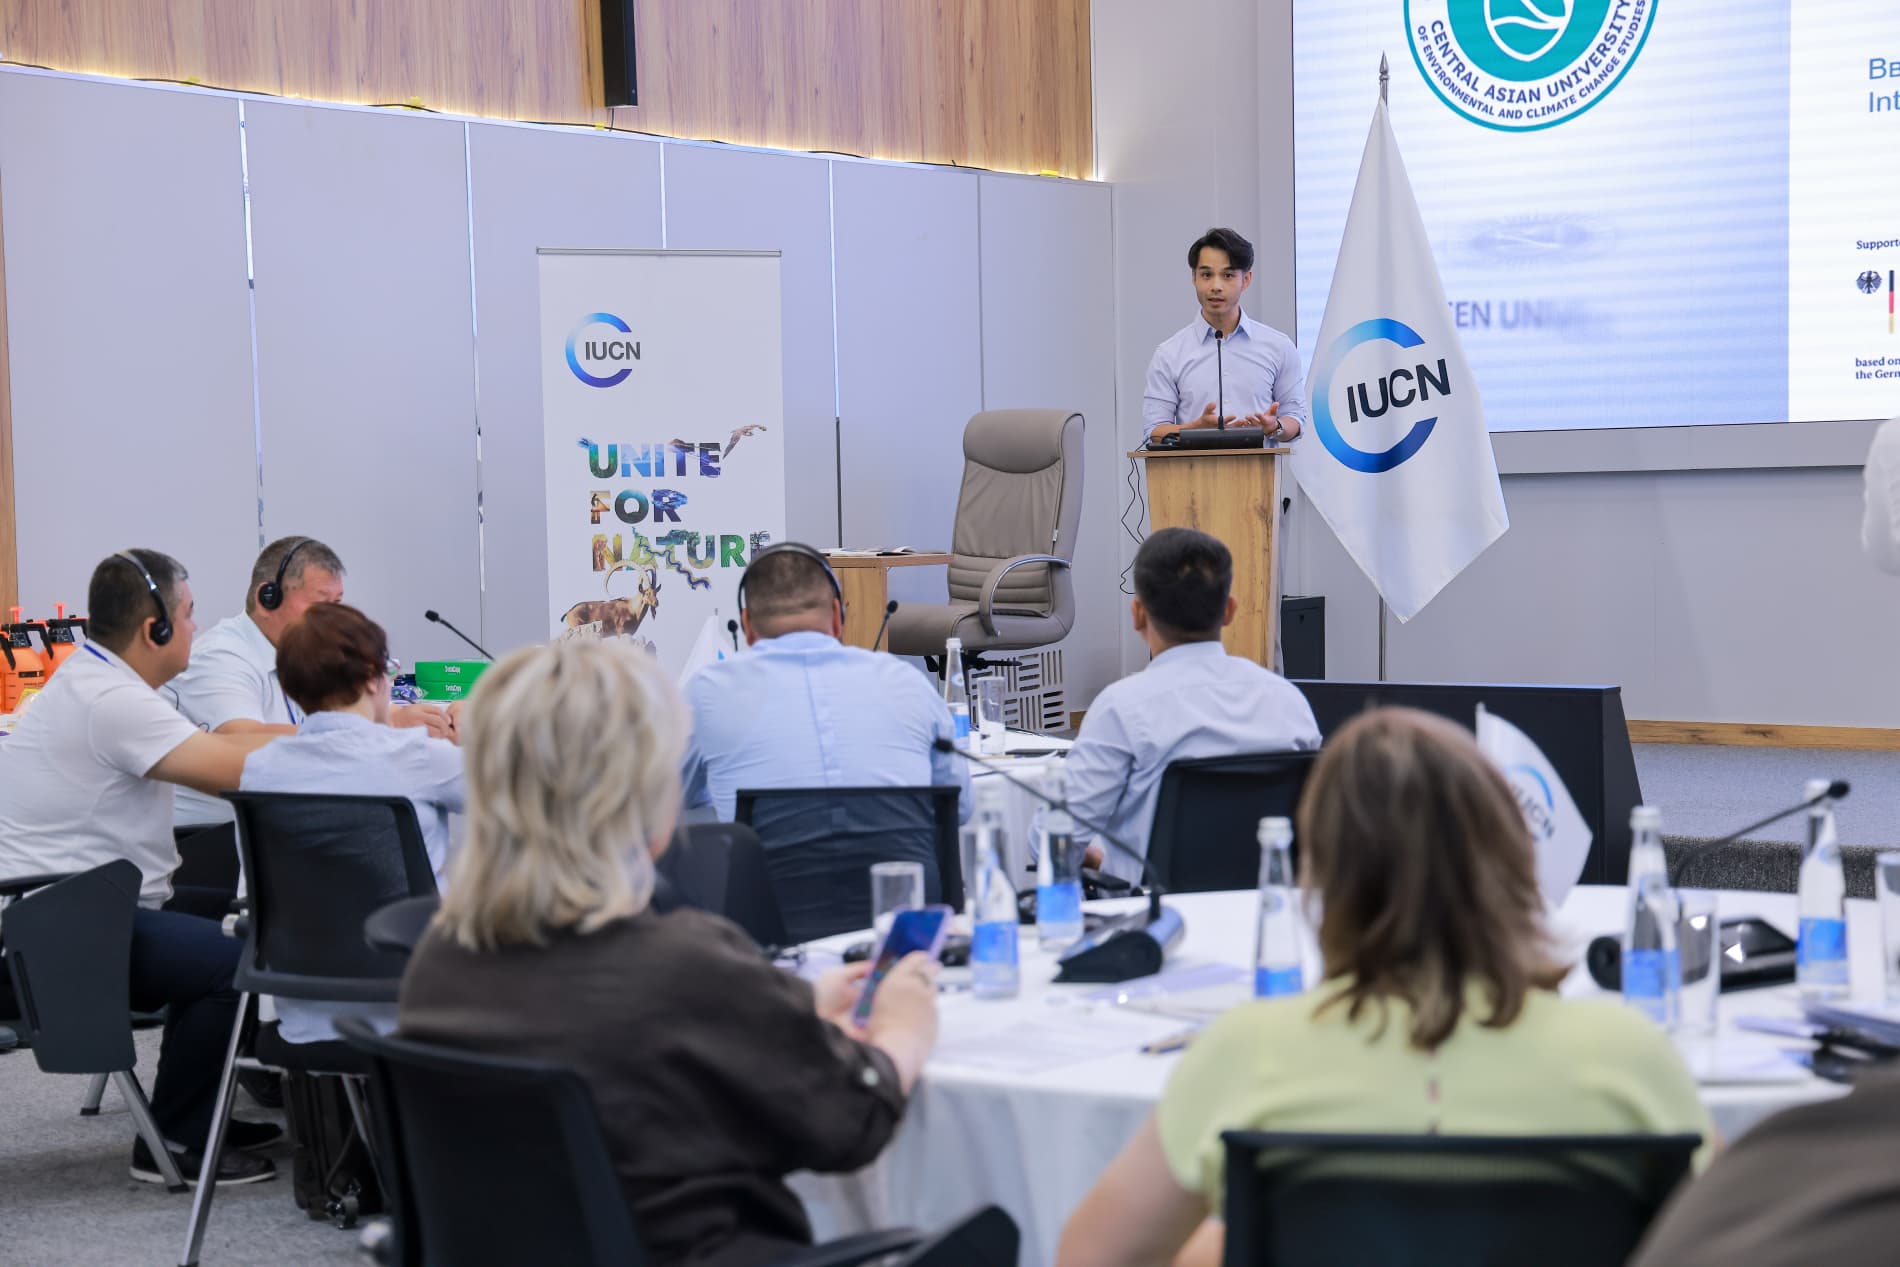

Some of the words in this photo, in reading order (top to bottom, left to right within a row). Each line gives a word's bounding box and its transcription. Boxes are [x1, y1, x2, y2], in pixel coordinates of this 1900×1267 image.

[1417, 25, 1429, 42] OF
[1423, 44, 1495, 116] ENVIRONMENTAL
[1498, 108, 1523, 120] AND
[1526, 94, 1577, 119] CLIMATE
[1579, 56, 1620, 98] CHANGE
[1617, 0, 1646, 56] STUDIES
[1431, 20, 1480, 92] CENTRAL
[1484, 84, 1541, 104] ASIAN
[1547, 0, 1631, 97] UNIVERSITY
[1869, 90, 1900, 113] Int
[1856, 238, 1900, 251] Support
[1448, 301, 1491, 328] EN
[585, 341, 641, 361] IUCN
[1855, 356, 1885, 367] based
[1855, 370, 1873, 380] the
[1346, 358, 1452, 424] IUCN
[588, 442, 721, 479] UNITE
[590, 489, 688, 525] FOR
